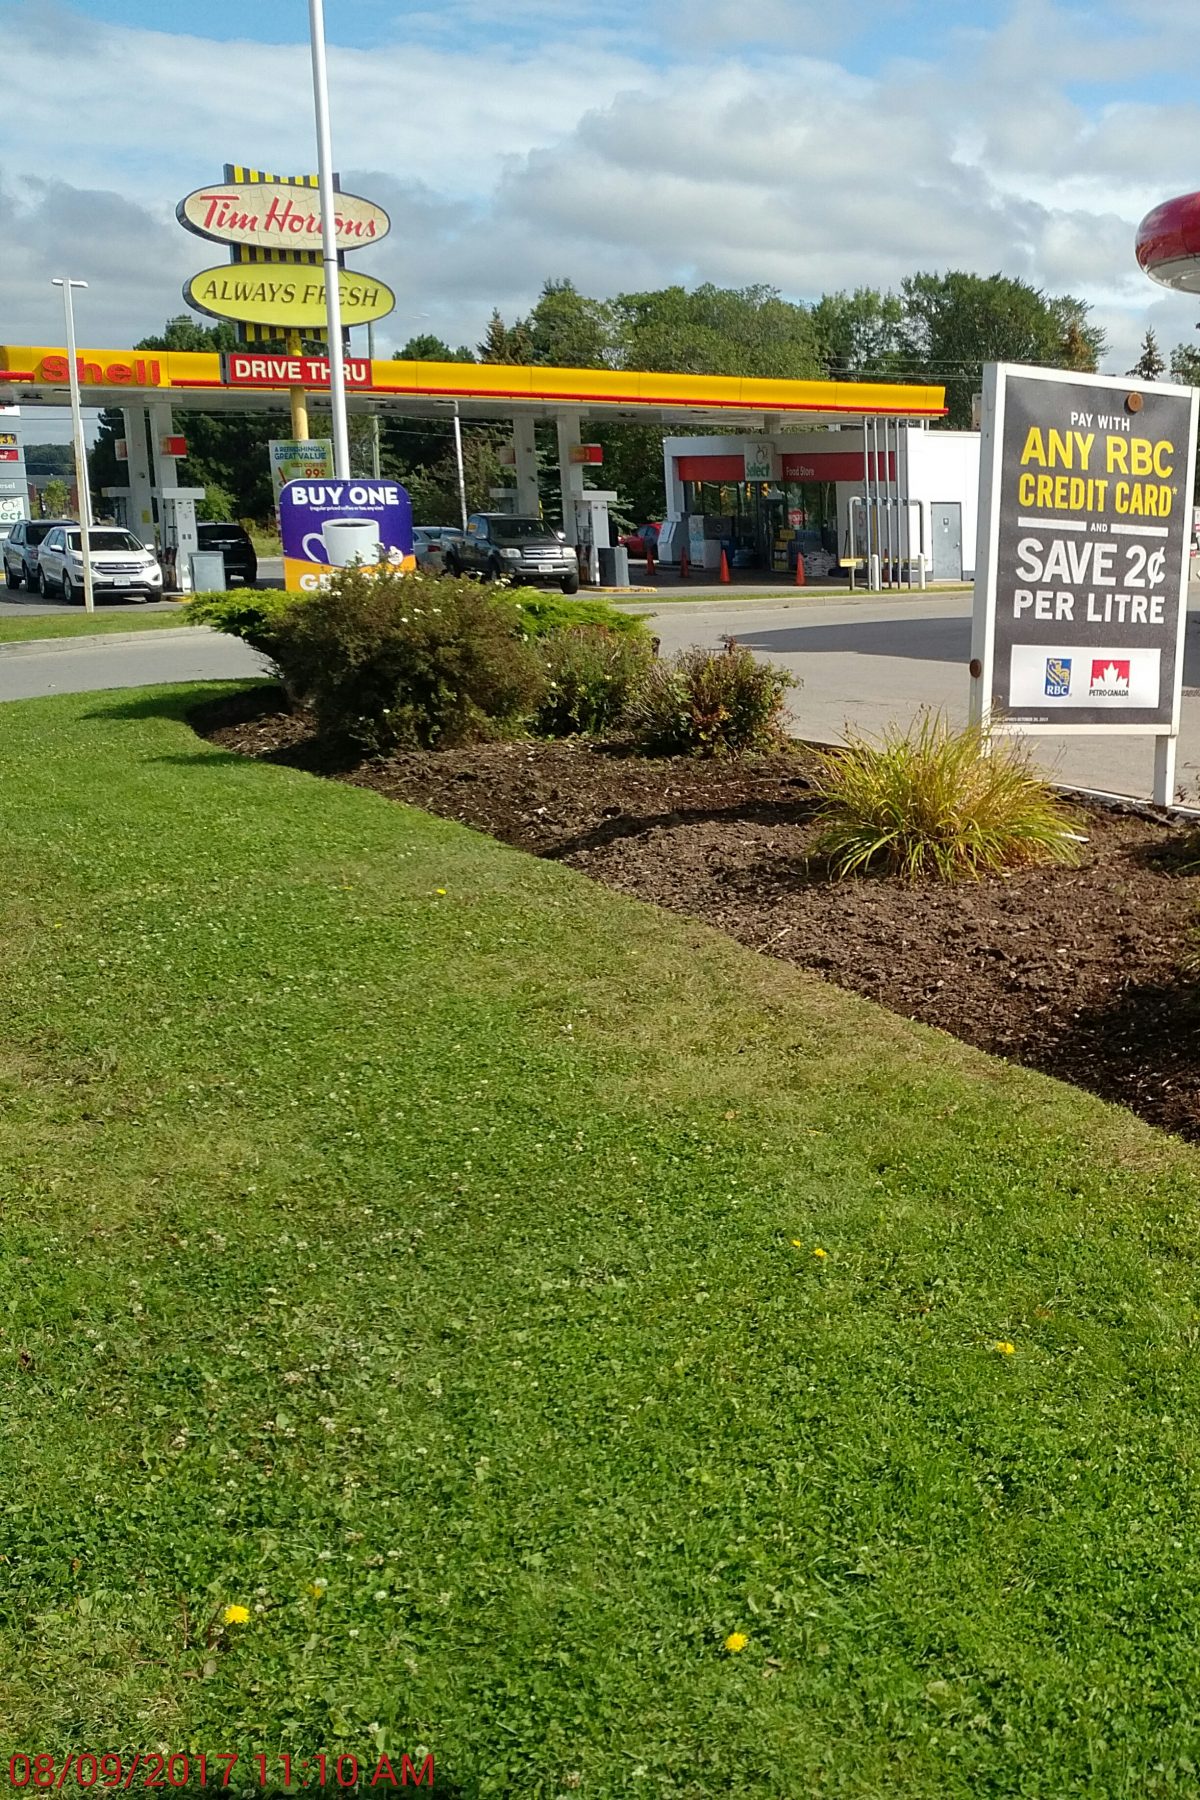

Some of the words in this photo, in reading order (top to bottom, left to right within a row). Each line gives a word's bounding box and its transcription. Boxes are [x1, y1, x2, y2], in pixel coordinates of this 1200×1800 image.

[200, 195, 259, 232] Tim
[202, 280, 296, 304] ALWAYS
[40, 356, 160, 385] Shell
[234, 359, 303, 380] DRIVE
[1070, 412, 1093, 427] PAY
[1097, 415, 1130, 432] WITH
[274, 452, 298, 460] GREAT
[298, 452, 327, 460] VALUE
[1020, 426, 1095, 471] ANY
[1106, 435, 1174, 478] RBC
[746, 463, 770, 477] Select
[786, 466, 800, 476] Food
[800, 466, 815, 476] Store
[291, 486, 343, 505] BUY
[349, 486, 399, 505] ONE
[1018, 473, 1108, 513] CREDIT
[1090, 522, 1108, 533] AND
[1015, 537, 1118, 587] SAVE
[1123, 545, 1166, 589] 2¢
[1013, 589, 1074, 621] PER
[1086, 593, 1166, 624] LITRE
[1046, 685, 1068, 696] RBC
